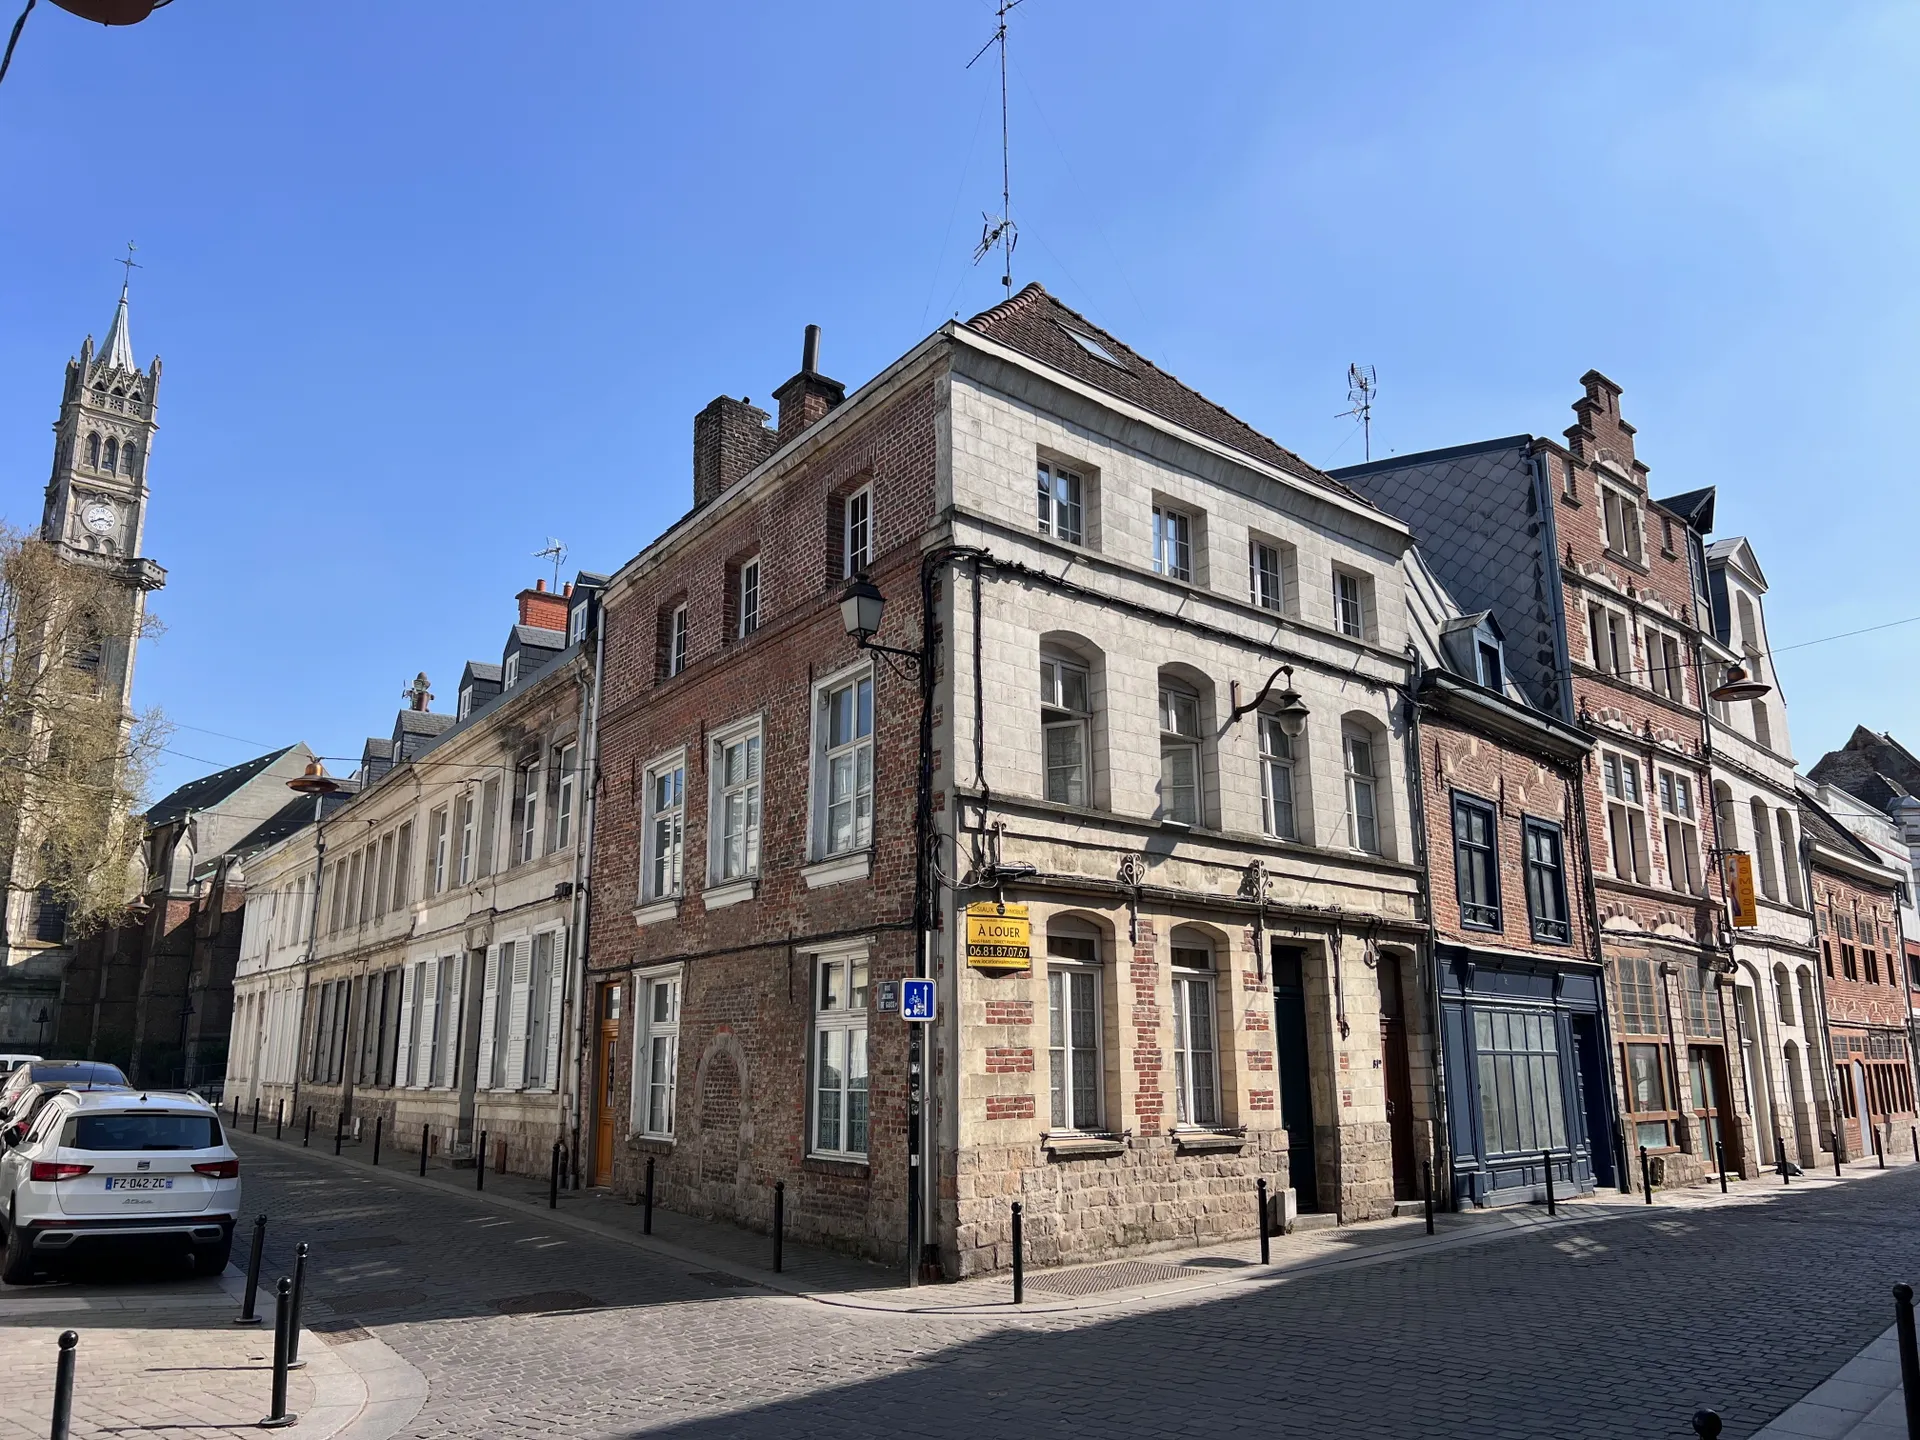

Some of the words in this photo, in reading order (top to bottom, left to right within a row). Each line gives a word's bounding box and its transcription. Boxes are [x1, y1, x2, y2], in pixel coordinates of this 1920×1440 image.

[1737, 856, 1754, 917] OSMOSE
[978, 923, 986, 937] À
[988, 926, 1020, 938] LOUER
[970, 945, 1029, 958] 06.81.87.07.67
